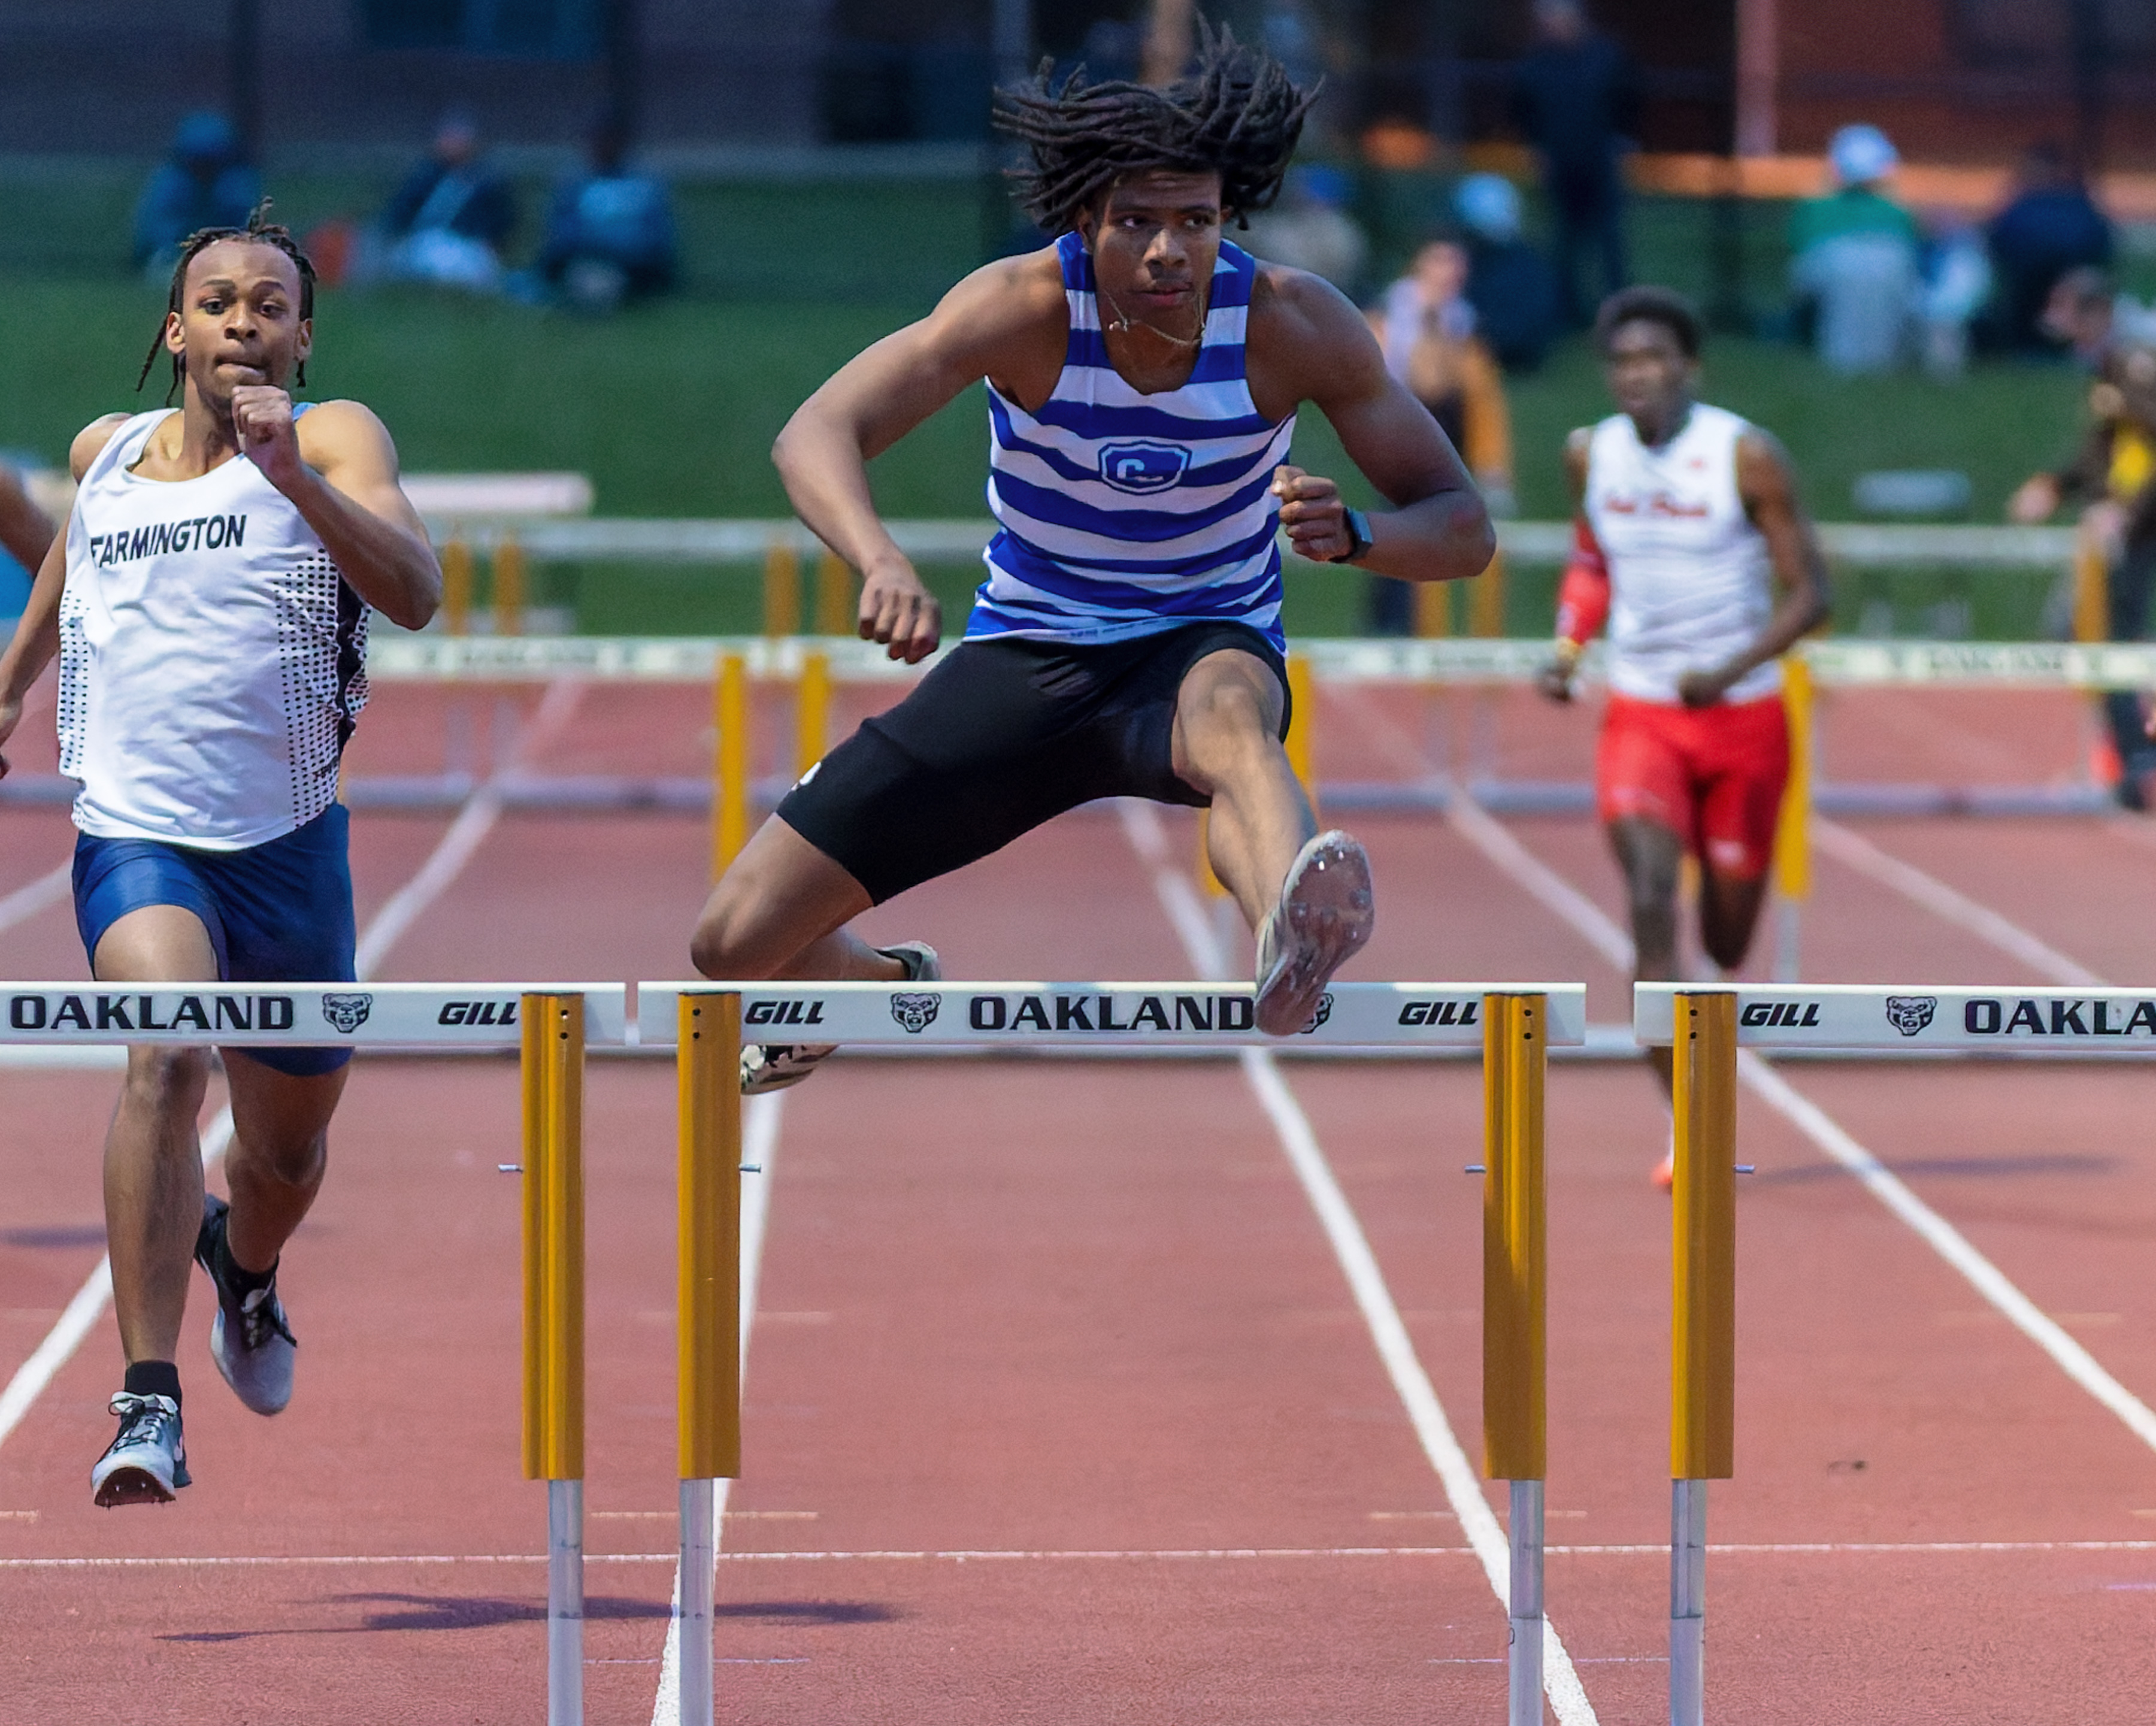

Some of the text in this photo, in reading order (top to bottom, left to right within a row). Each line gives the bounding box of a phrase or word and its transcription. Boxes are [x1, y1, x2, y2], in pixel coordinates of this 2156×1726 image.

[91, 514, 247, 568] FARMINGTON
[10, 995, 295, 1030] OAKLAND
[437, 1002, 517, 1026] GILL
[743, 1001, 825, 1025] GILL
[969, 996, 1255, 1031] OAKLAND
[1398, 1001, 1479, 1026] GILL
[1740, 1003, 1820, 1027] GILL
[1964, 1000, 2156, 1035] OAKLA
